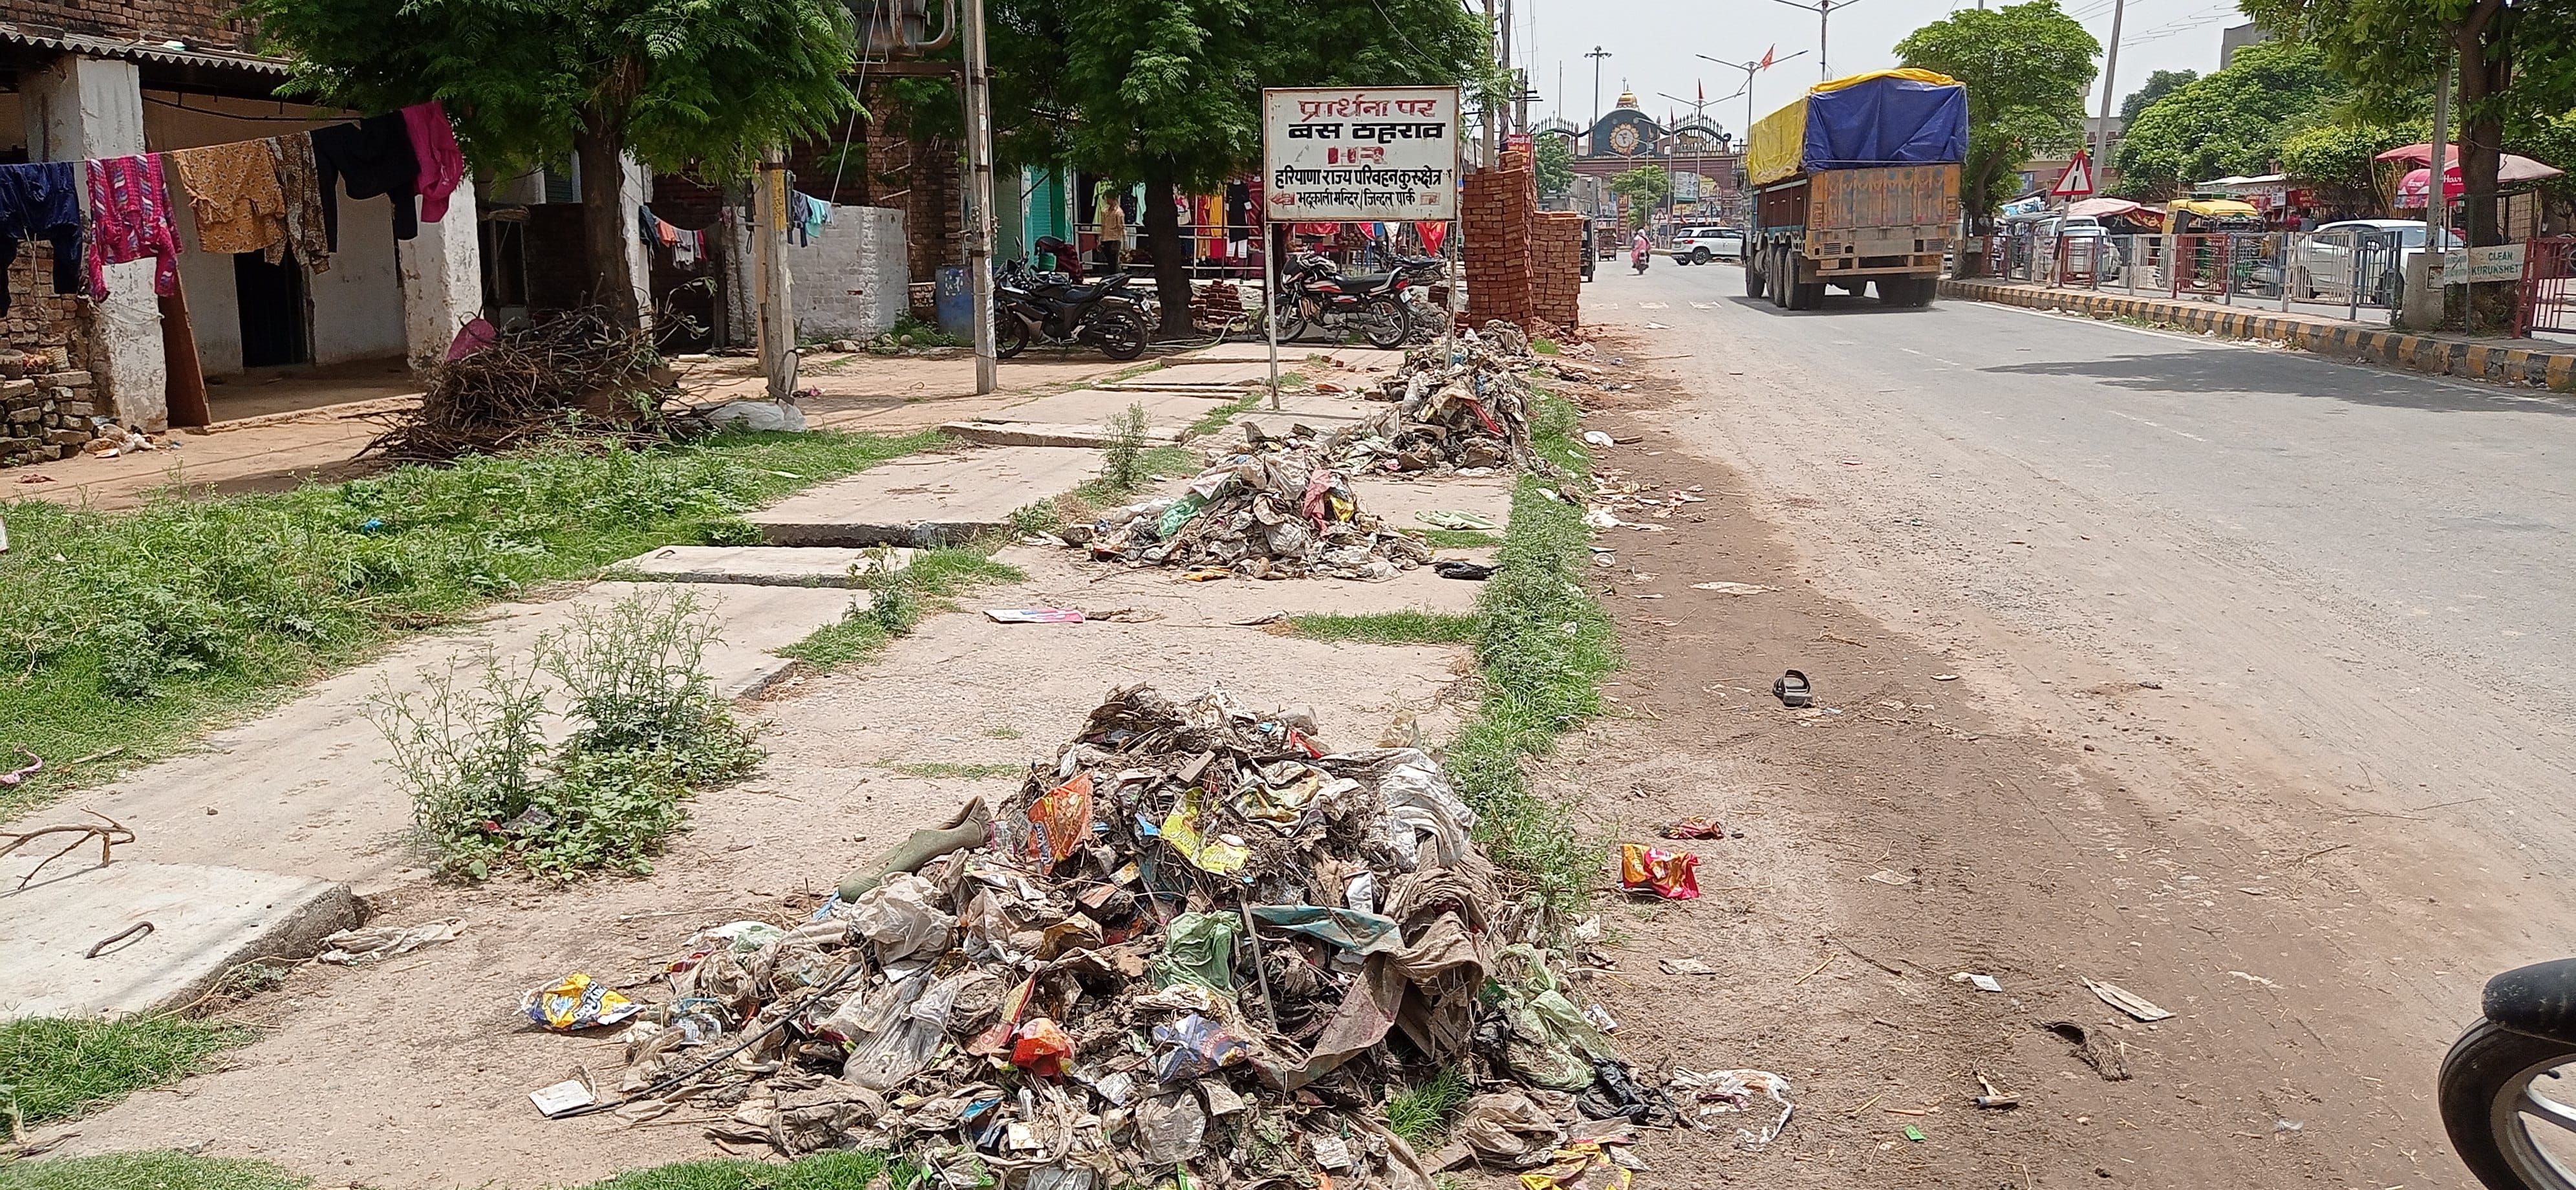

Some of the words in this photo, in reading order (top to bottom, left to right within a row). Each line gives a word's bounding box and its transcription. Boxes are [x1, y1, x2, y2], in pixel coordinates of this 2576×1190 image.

[1298, 94, 1391, 122] प्रार्थना
[1395, 100, 1437, 117] पर
[1289, 123, 1344, 139] बस
[1352, 123, 1446, 144] ठहराव
[1275, 165, 1322, 189] हरियाणा
[1322, 169, 1353, 185] राज्य
[1354, 164, 1399, 188] परिवहन
[1395, 188, 1415, 206] पार्क
[2488, 251, 2513, 261] CLEAN
